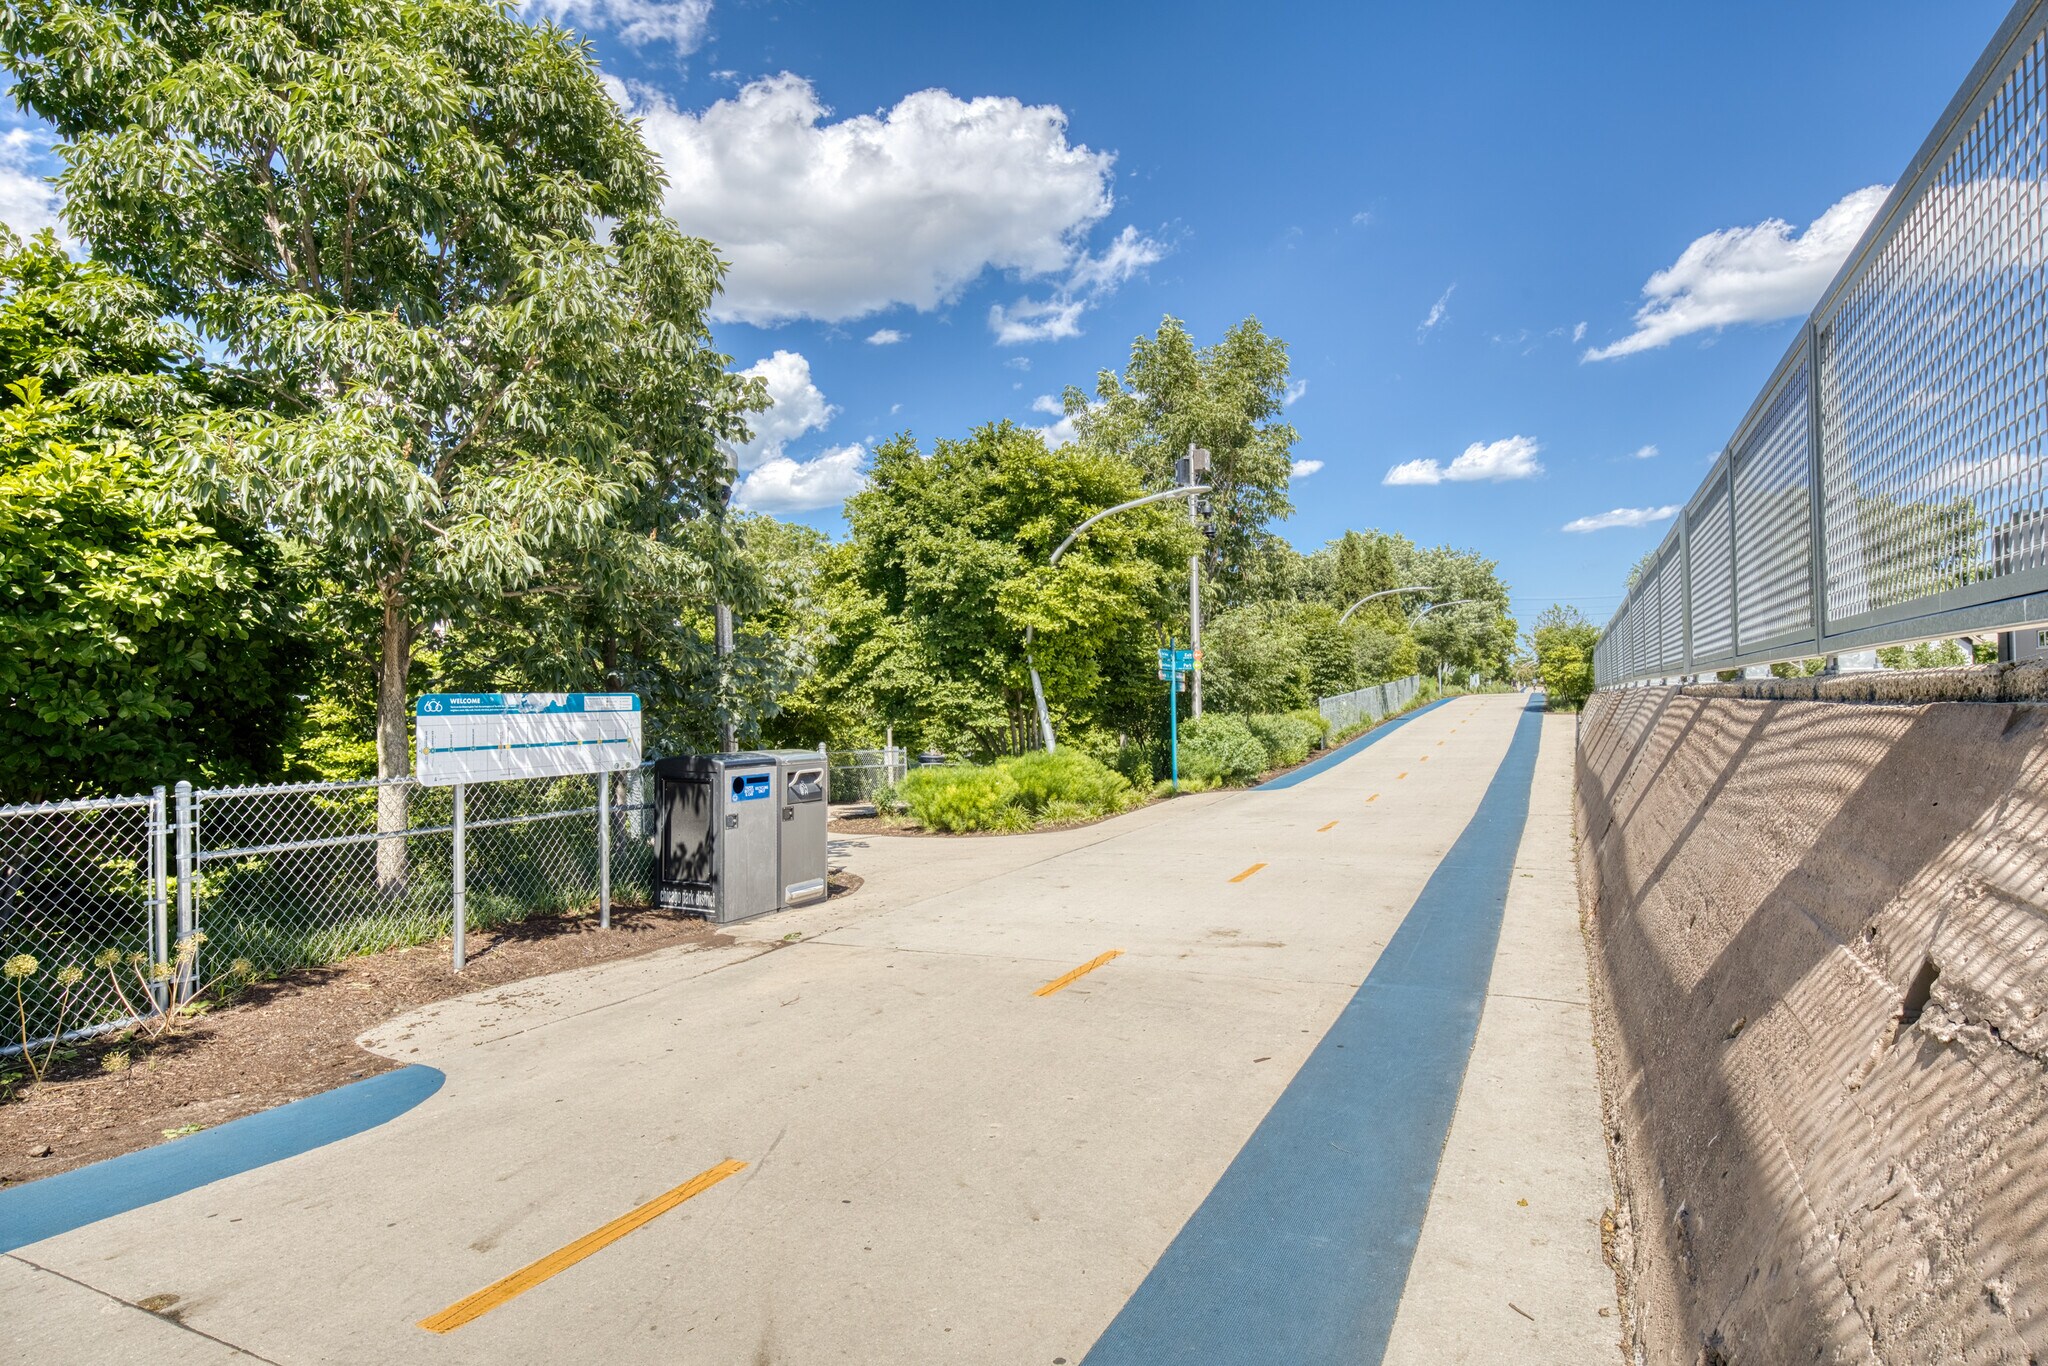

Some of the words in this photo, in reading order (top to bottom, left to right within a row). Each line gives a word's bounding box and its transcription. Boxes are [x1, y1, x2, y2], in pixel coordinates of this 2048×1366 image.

[660, 887, 681, 907] chicago
[682, 891, 694, 908] park
[696, 890, 715, 908] district
